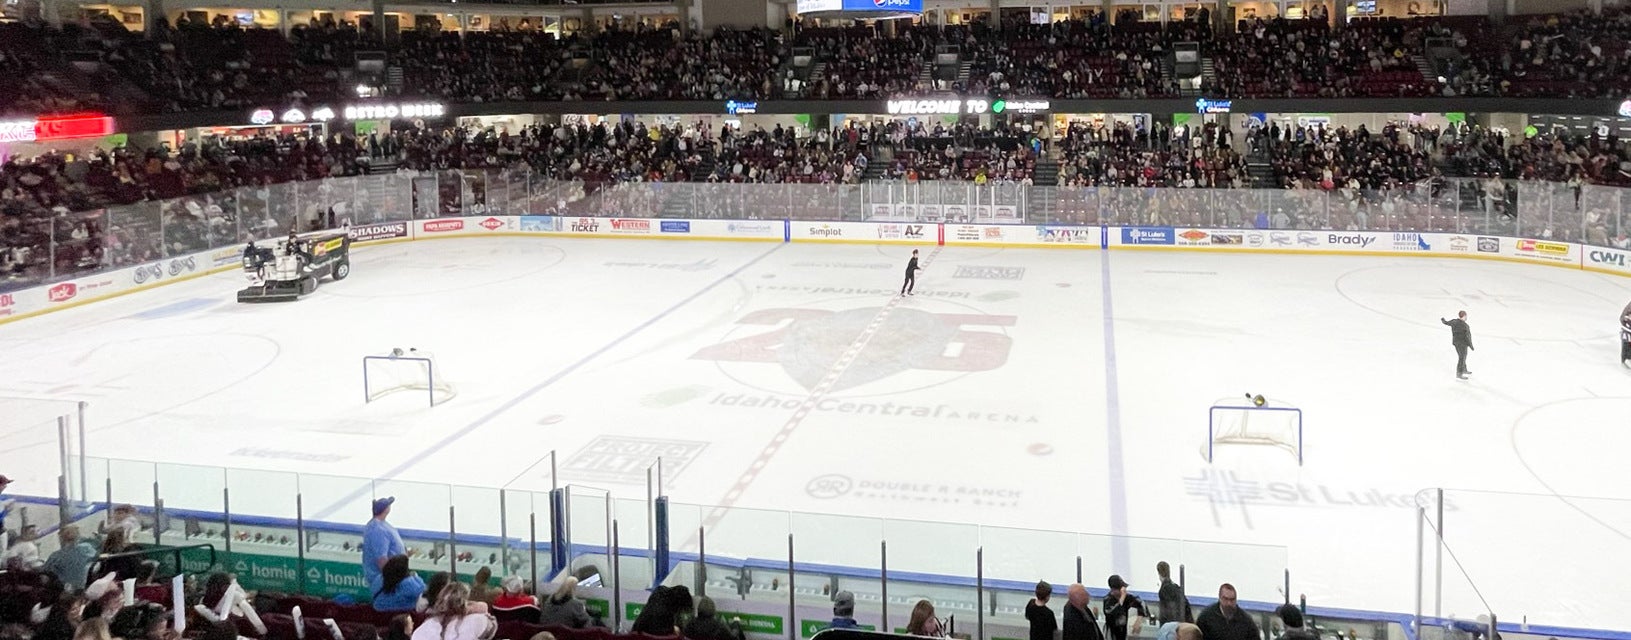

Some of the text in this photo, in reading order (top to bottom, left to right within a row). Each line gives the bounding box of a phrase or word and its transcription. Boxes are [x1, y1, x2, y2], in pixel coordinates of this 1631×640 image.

[345, 105, 398, 119] RETRO
[887, 100, 988, 114] WELCOME TO
[351, 223, 404, 239] SHADOWS
[571, 224, 599, 232] TICKET
[610, 219, 650, 230] WESTERN
[905, 225, 924, 236] AZ
[810, 227, 842, 237] Simplot
[1393, 233, 1417, 241] IDAHO
[1328, 234, 1369, 248] Brady
[1590, 251, 1625, 266] CWI
[708, 391, 1041, 424] Idaho Central ARENA
[1267, 482, 1316, 503] St
[181, 556, 223, 572] home
[252, 563, 296, 580] homie
